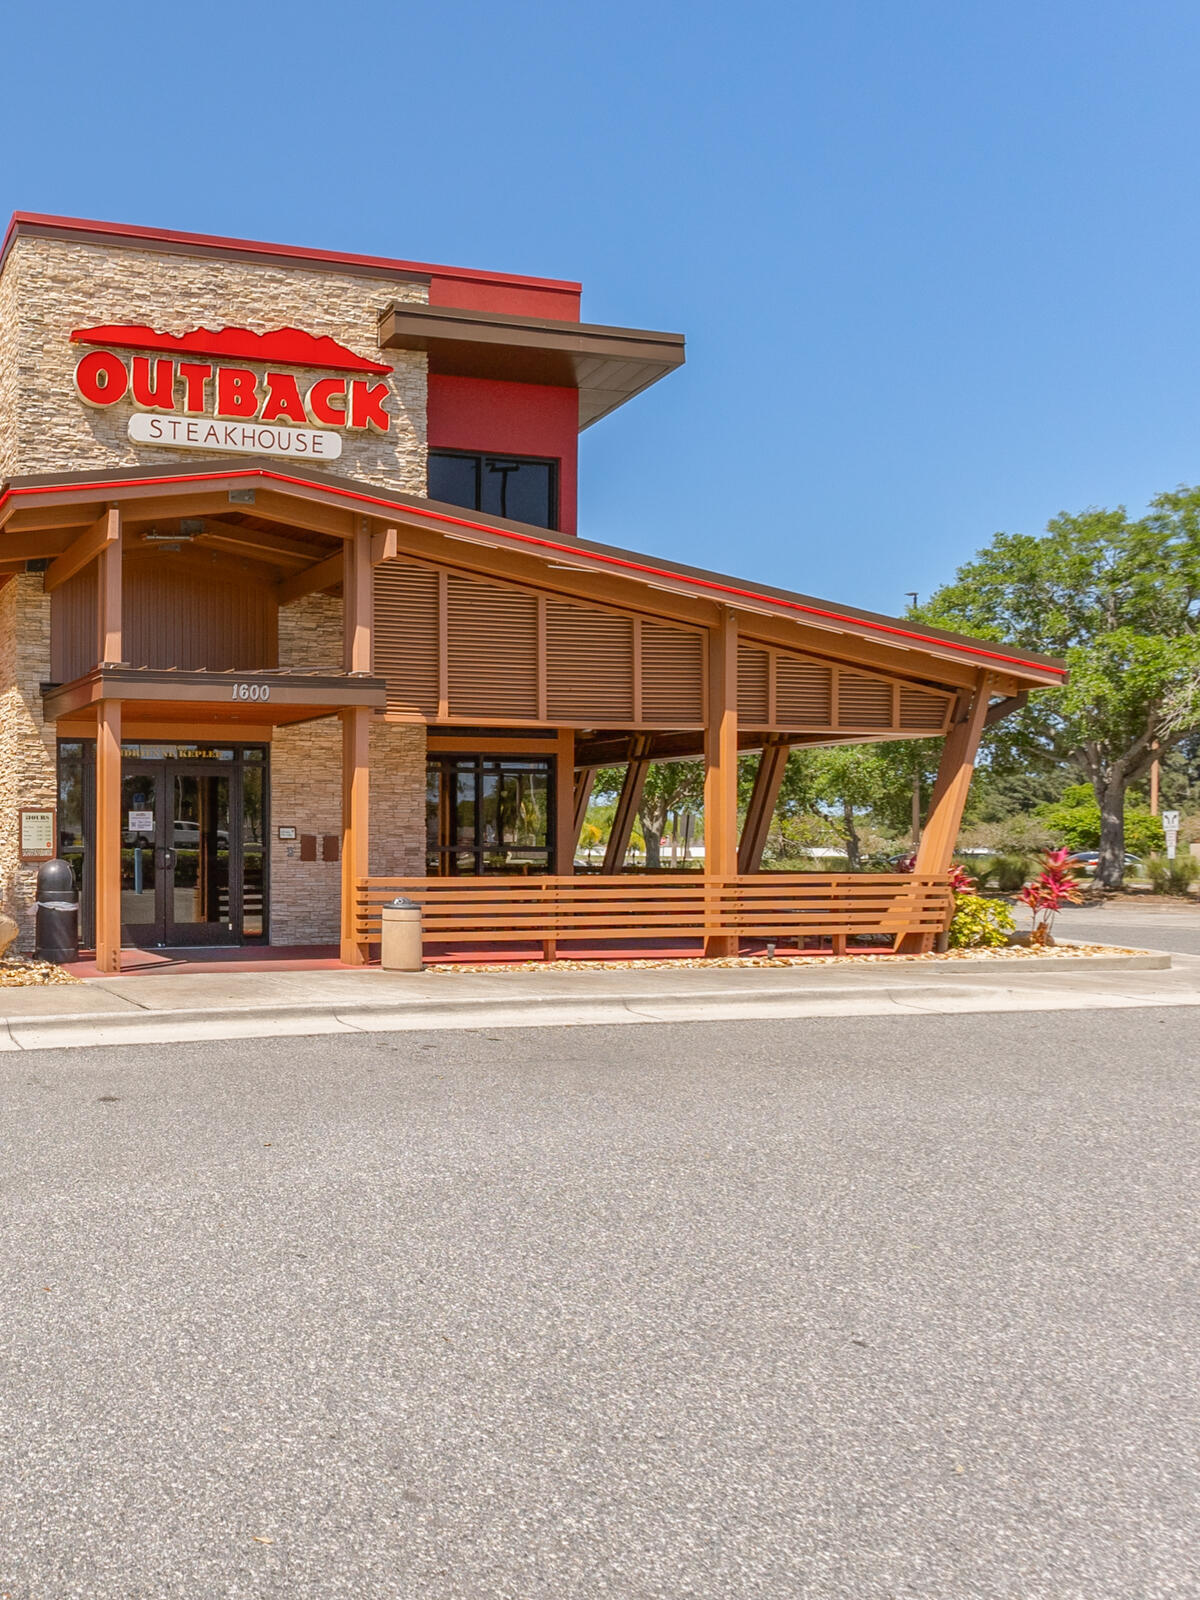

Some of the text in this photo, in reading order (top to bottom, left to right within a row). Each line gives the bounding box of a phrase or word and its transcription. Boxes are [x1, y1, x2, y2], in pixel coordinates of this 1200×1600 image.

[75, 350, 391, 433] OUTBACK
[149, 418, 324, 454] STEAKHOUSE
[231, 683, 270, 701] 1600
